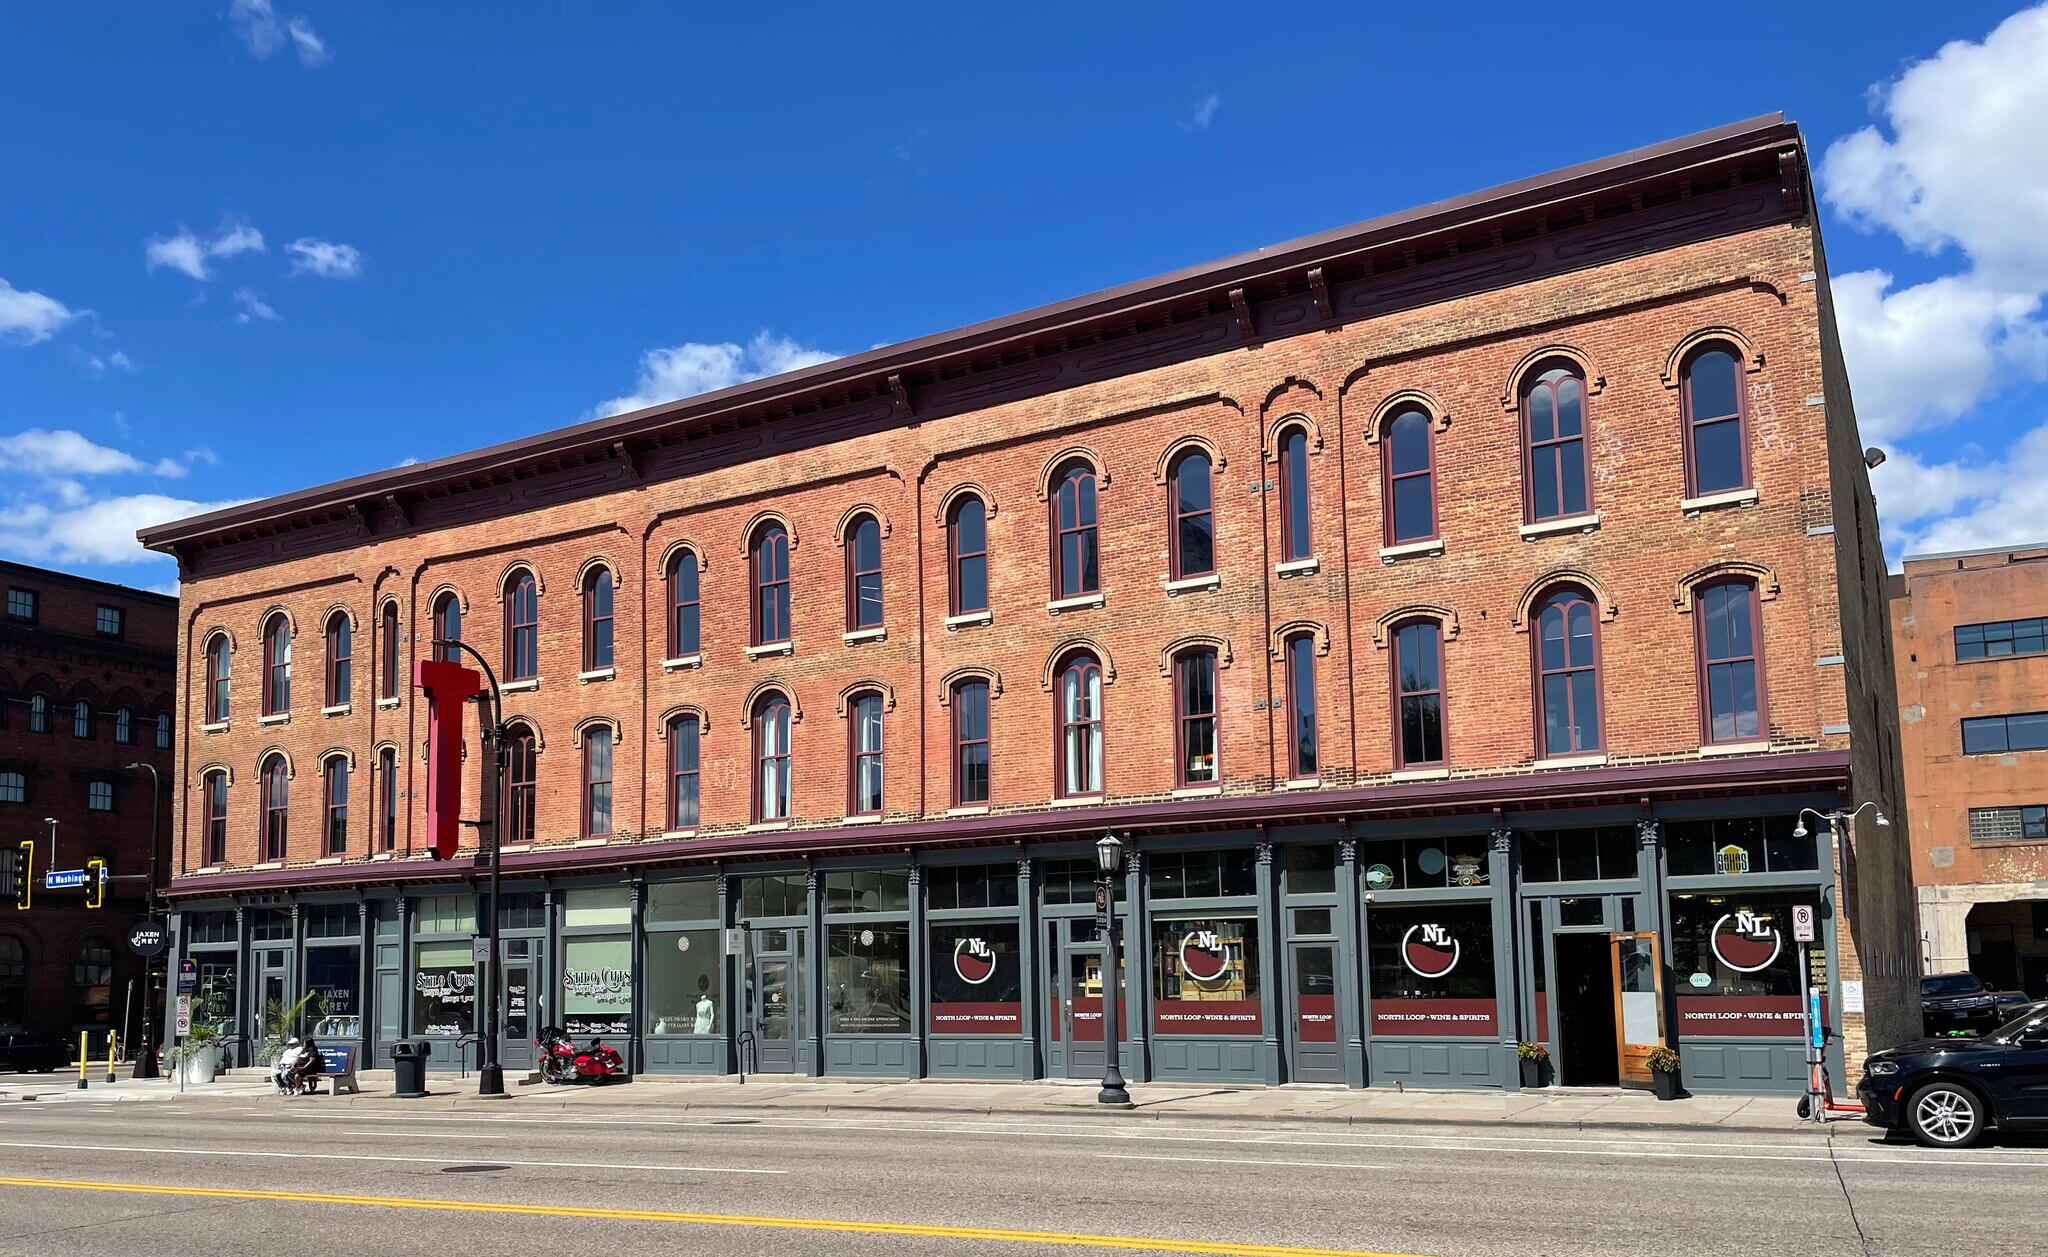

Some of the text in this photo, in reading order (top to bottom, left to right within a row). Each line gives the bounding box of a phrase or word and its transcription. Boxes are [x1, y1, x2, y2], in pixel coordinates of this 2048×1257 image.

[48, 876, 54, 884] N
[1735, 913, 1770, 936] NL
[1198, 931, 1222, 950] NL
[1422, 924, 1451, 945] NL
[968, 938, 990, 956] NL
[324, 990, 349, 1000] JAXEN
